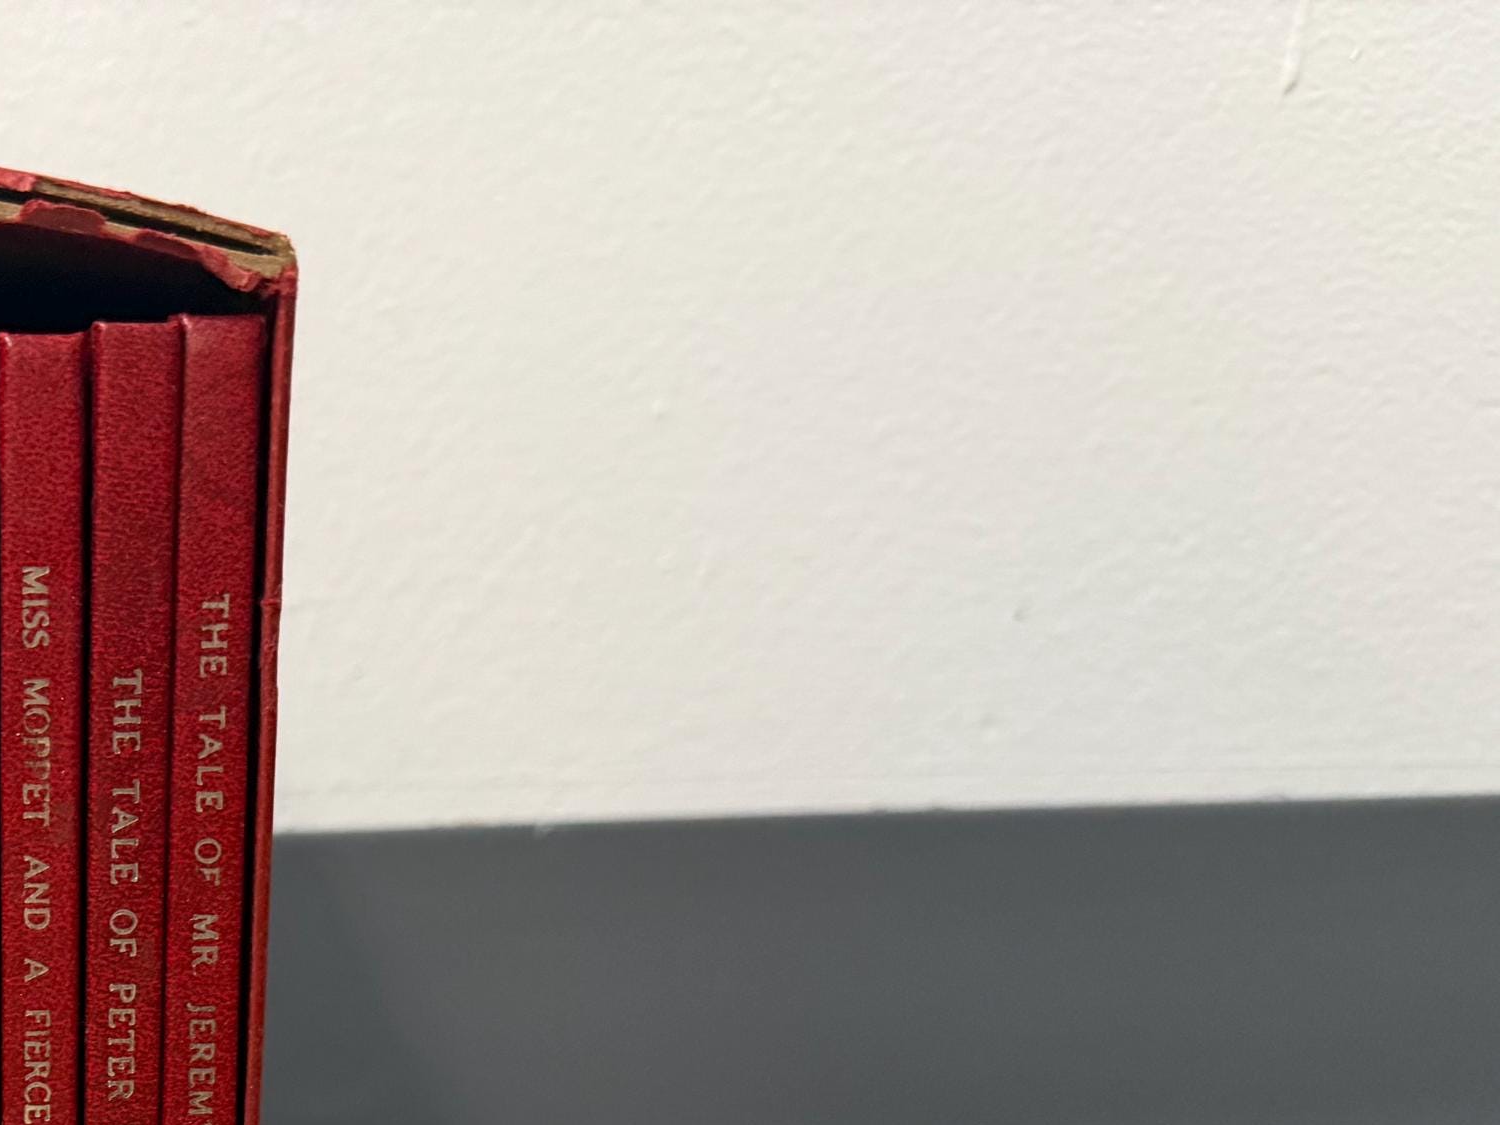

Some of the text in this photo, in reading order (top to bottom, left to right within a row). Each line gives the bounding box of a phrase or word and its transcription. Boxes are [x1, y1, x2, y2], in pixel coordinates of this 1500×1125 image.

[22, 566, 50, 650] MISS
[200, 593, 230, 678] THE
[22, 678, 51, 827] MOPPET
[112, 669, 144, 755] THE
[195, 706, 227, 814] TALE
[110, 780, 140, 885] TALE
[194, 838, 222, 886] OF
[23, 855, 51, 931] AND
[109, 908, 138, 958] OF
[24, 958, 50, 983] A
[24, 1009, 52, 1125] FIERCE
[107, 983, 136, 1101] PETER
